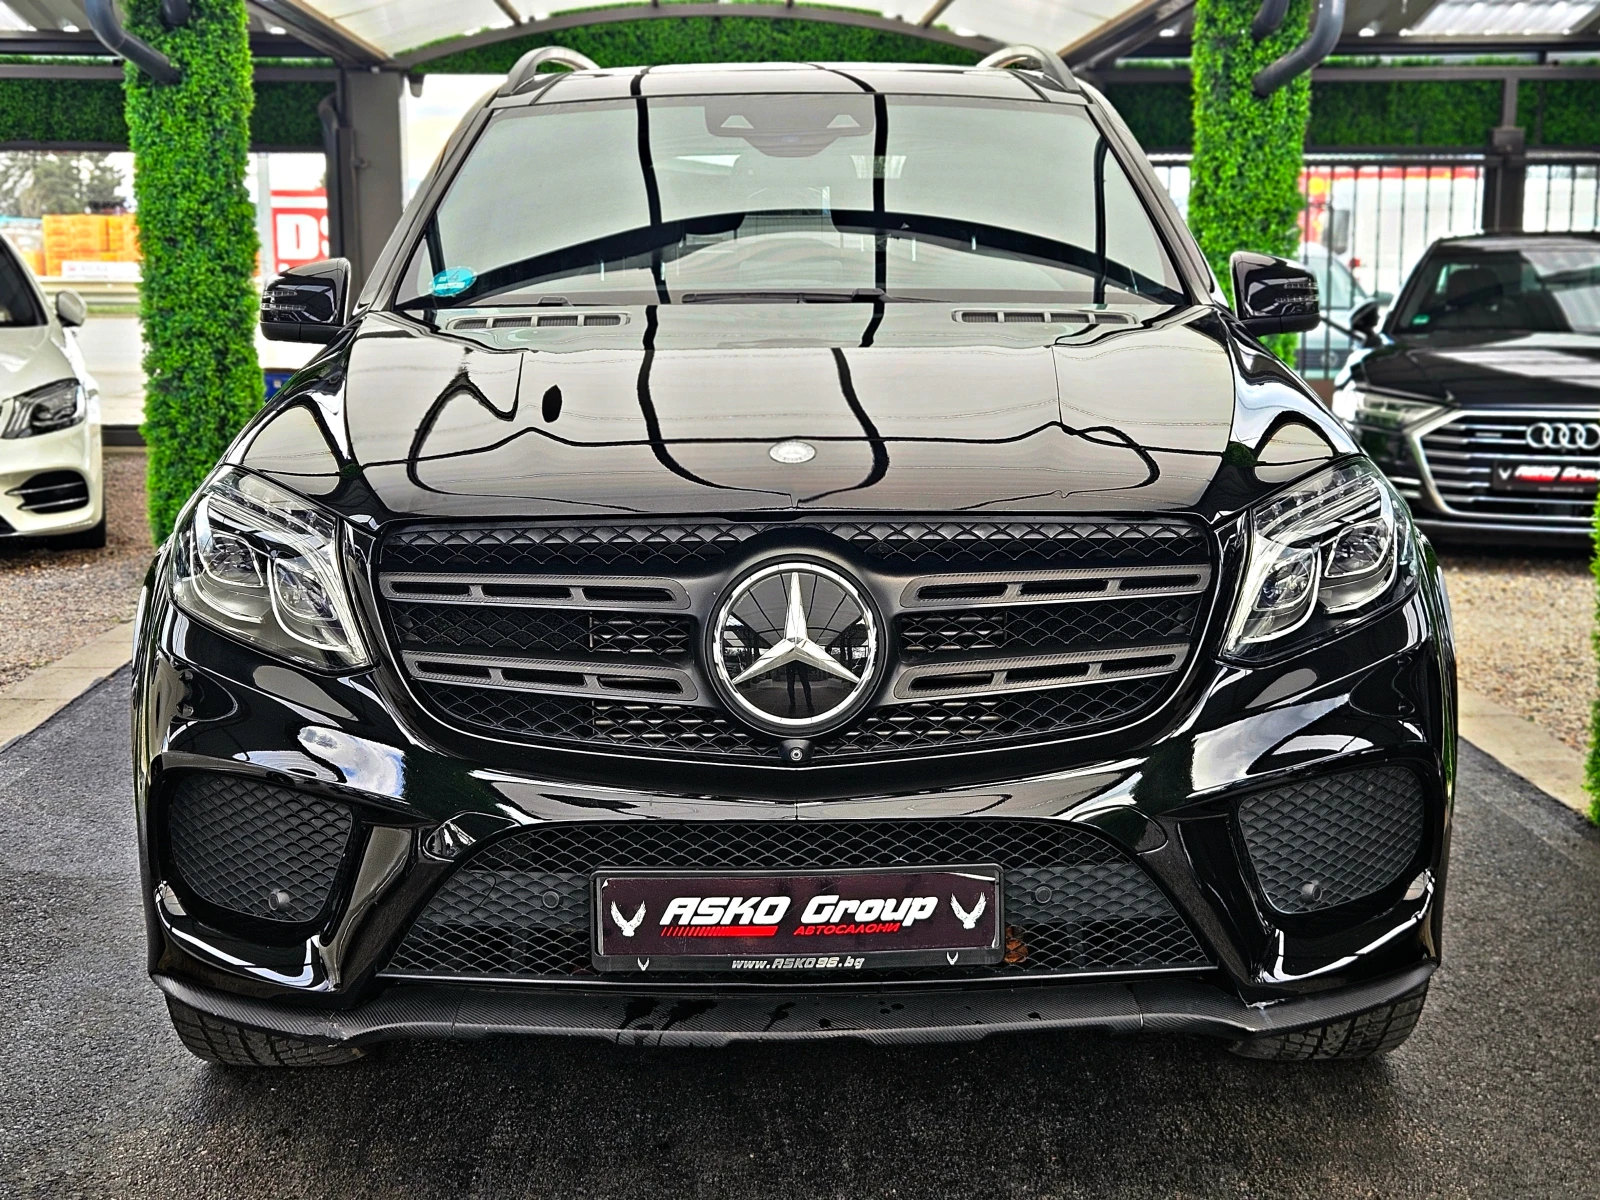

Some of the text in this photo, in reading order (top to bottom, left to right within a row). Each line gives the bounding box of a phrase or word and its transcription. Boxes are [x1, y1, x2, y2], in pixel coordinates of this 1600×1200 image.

[660, 895, 938, 926] ASKO Group
[794, 923, 901, 935] АВТОСАЛОНИ
[732, 956, 865, 969] www.ASKO96.bg
